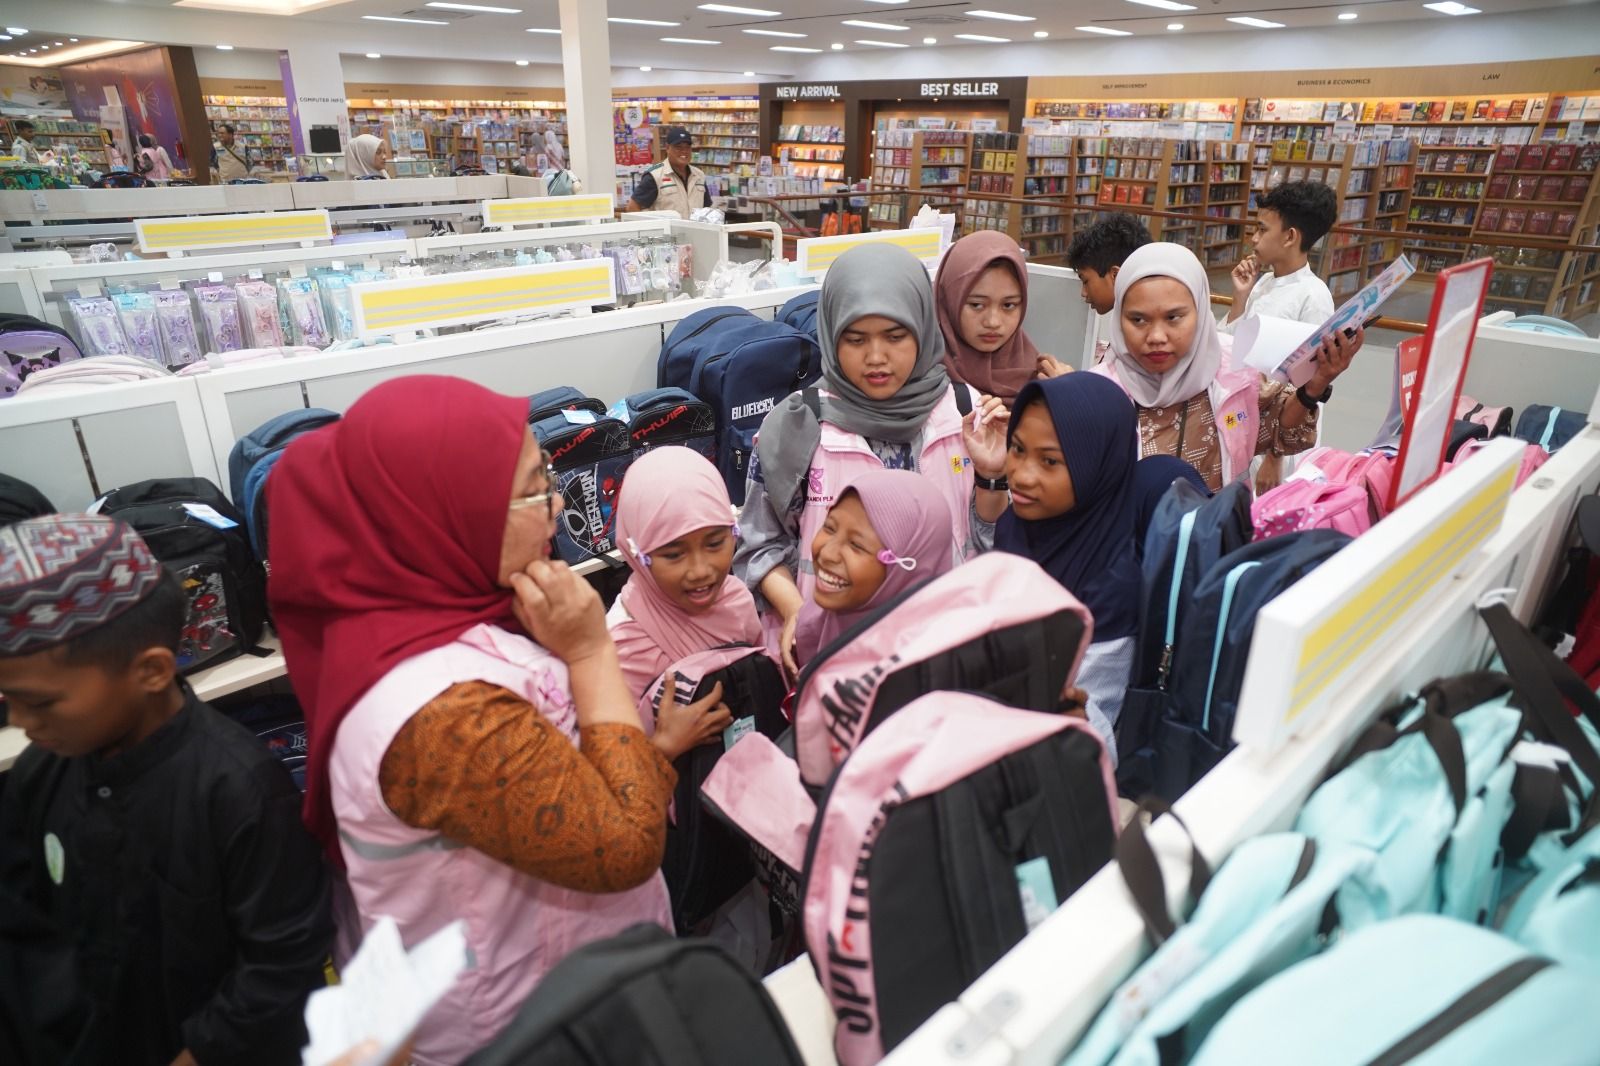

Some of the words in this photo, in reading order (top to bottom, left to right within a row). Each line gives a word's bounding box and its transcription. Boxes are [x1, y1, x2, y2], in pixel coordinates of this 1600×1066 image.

[776, 86, 798, 98] NEW
[799, 85, 841, 97] ARRIVAL
[920, 83, 950, 96] BEST
[952, 82, 999, 96] SELLER
[731, 397, 775, 420] BLUELOCK
[550, 427, 596, 462] HWIP!
